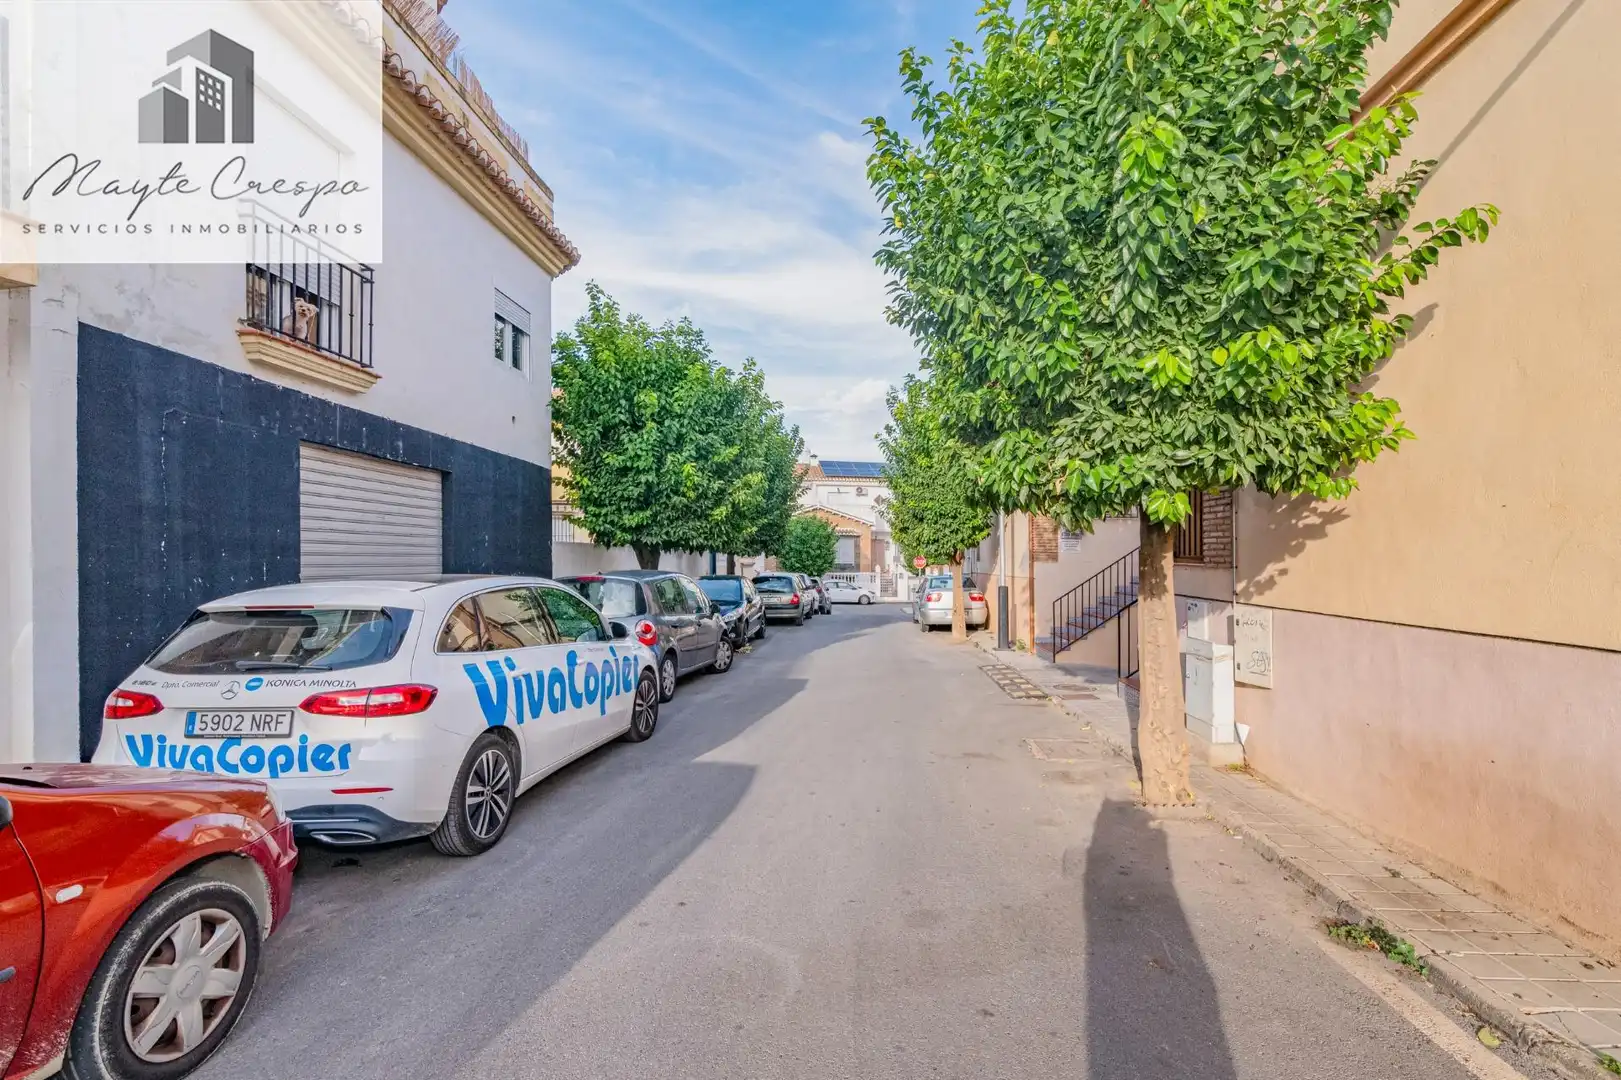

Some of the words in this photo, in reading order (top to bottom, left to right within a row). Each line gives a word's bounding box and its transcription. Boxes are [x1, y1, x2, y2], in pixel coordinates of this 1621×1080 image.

[265, 679, 306, 688] KONICA
[309, 679, 357, 688] MINOLTA
[462, 645, 639, 728] VivaCopier
[198, 713, 245, 732] 5902
[250, 713, 287, 732] NRF
[125, 733, 352, 779] VivaCopier
